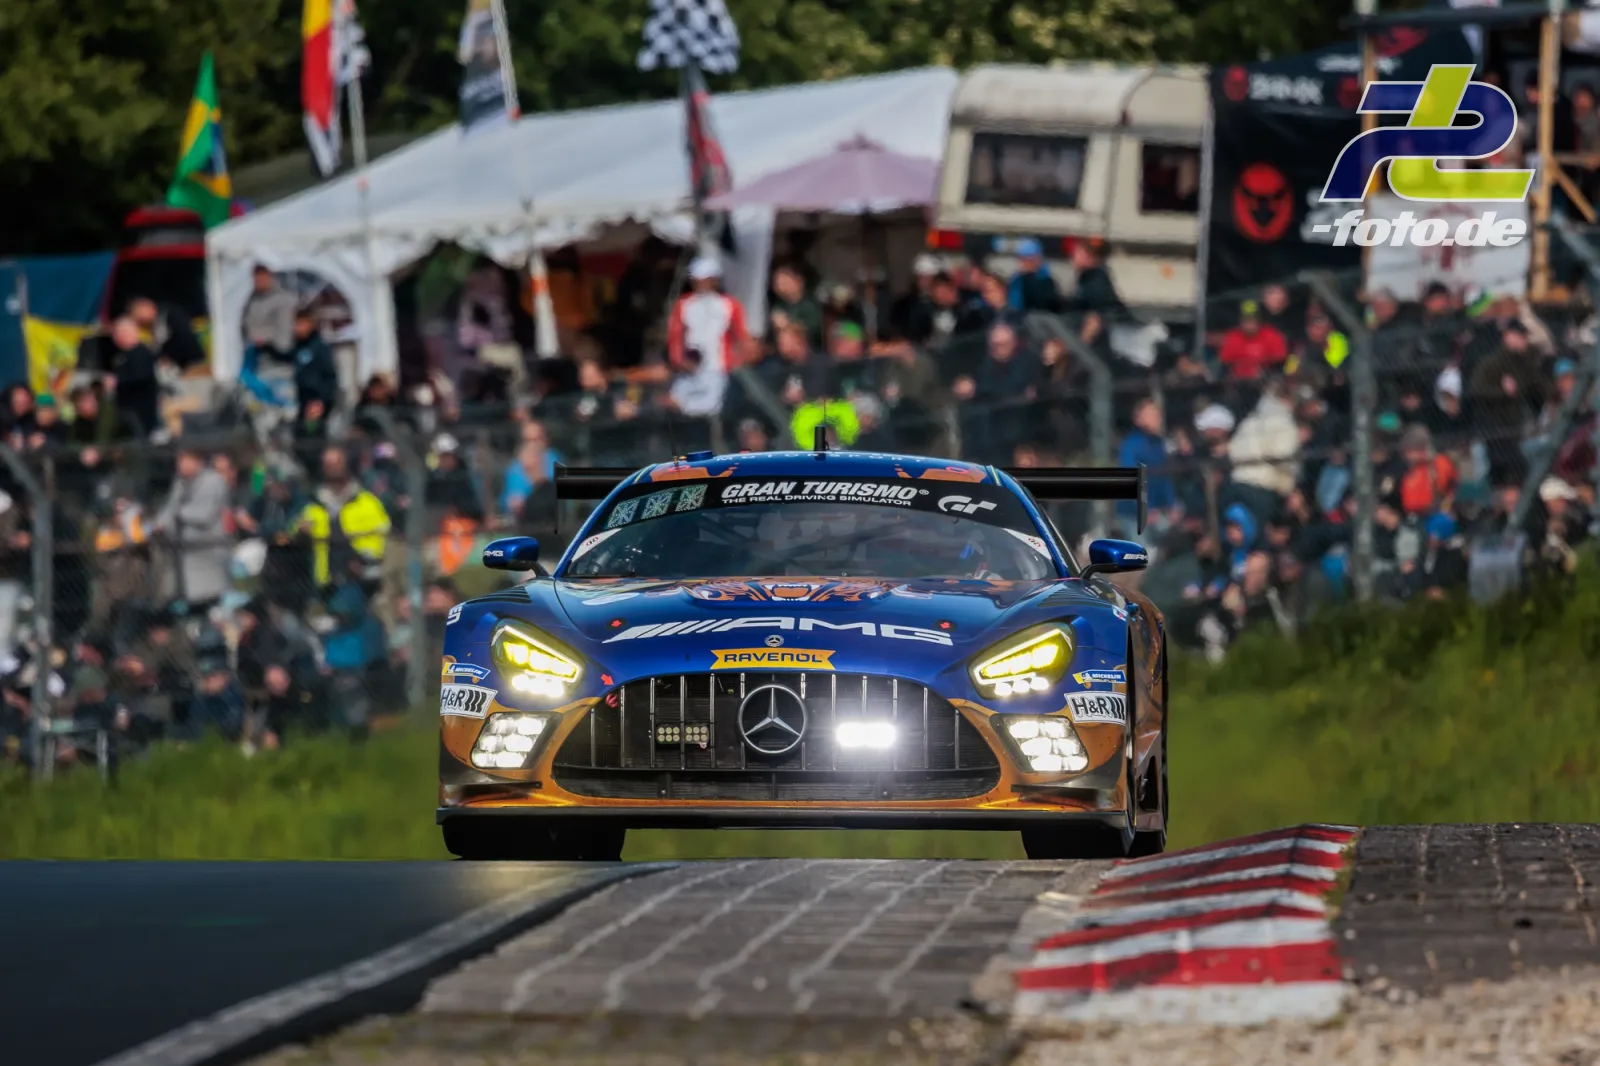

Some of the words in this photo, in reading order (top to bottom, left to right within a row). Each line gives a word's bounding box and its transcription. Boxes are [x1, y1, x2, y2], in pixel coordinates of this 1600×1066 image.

[721, 481, 798, 499] GRAN
[839, 494, 912, 506] SIMULATOR
[712, 617, 954, 646] AMG
[723, 652, 823, 663] RAVENOL
[455, 667, 484, 675] MICHELIN
[441, 688, 466, 708] H&R
[1071, 696, 1112, 715] H&R
